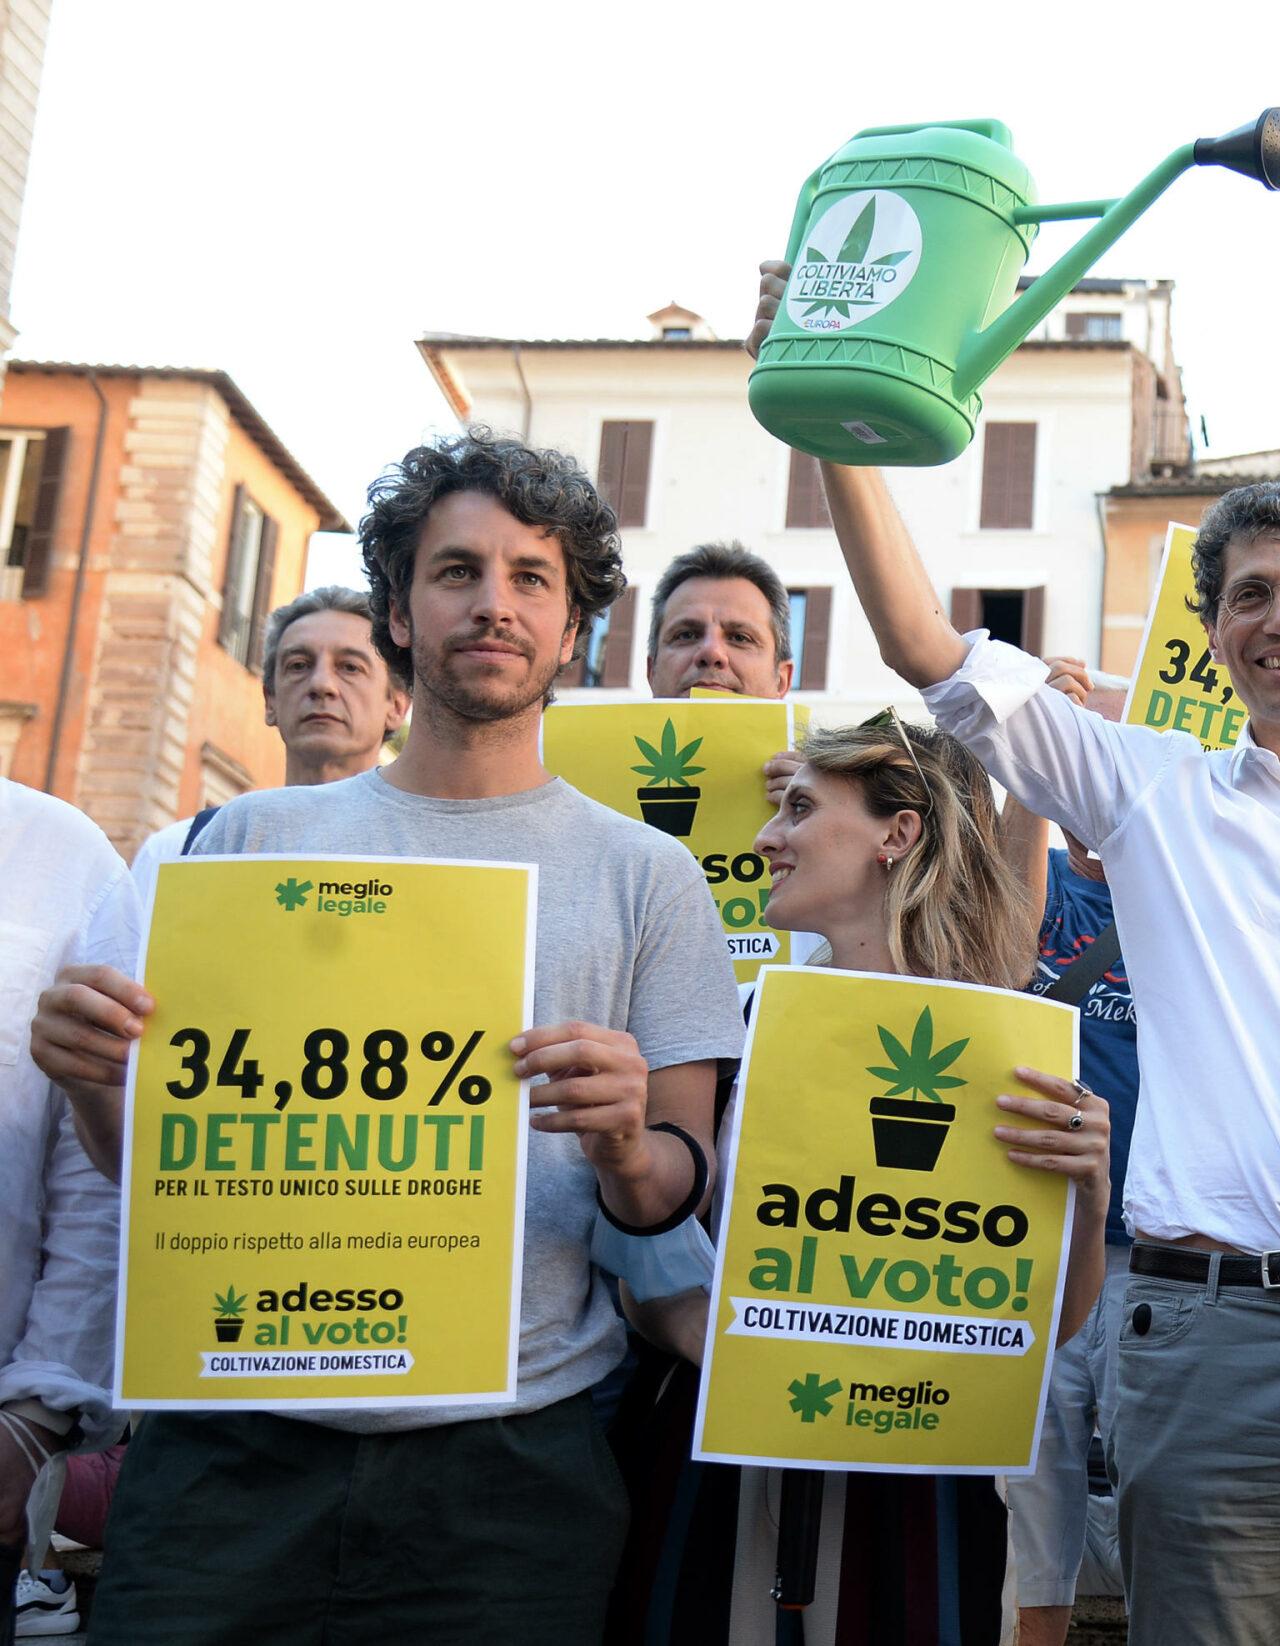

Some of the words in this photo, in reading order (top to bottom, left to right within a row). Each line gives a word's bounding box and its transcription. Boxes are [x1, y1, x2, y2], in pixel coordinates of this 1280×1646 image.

[797, 265, 897, 283] COLTIVIAMO
[804, 319, 841, 329] EUROPA
[1145, 689, 1245, 746] DETE
[694, 853, 764, 884] so
[319, 879, 392, 899] meglio
[318, 896, 386, 916] legale
[712, 889, 770, 928] o!
[727, 938, 772, 954] STICA
[166, 1028, 492, 1111] 34,88%
[160, 1113, 484, 1172] DETENUTI
[155, 1180, 187, 1196] PER
[194, 1180, 209, 1196] IL
[215, 1180, 273, 1196] TESTO
[280, 1179, 338, 1196] UNICO
[346, 1179, 401, 1195] SULLE
[408, 1179, 481, 1195] DROGHE
[757, 1175, 1028, 1247] adesso
[156, 1233, 165, 1249] Il
[170, 1233, 228, 1254] doppio
[234, 1232, 303, 1254] rispetto
[309, 1232, 341, 1249] alla
[348, 1232, 402, 1249] media
[408, 1236, 479, 1252] europea
[749, 1236, 818, 1294] al
[840, 1254, 1033, 1312] voto!
[257, 1282, 403, 1312] adesso
[255, 1315, 289, 1345] al
[302, 1316, 407, 1345] voto!
[744, 1306, 899, 1339] COLTIVAZIONE
[904, 1320, 1024, 1347] DOMESTICA
[211, 1357, 316, 1371] COLTIVAZIONE
[320, 1355, 406, 1370] DOMESTICA
[850, 1381, 949, 1409] meglio
[846, 1402, 939, 1434] legale
